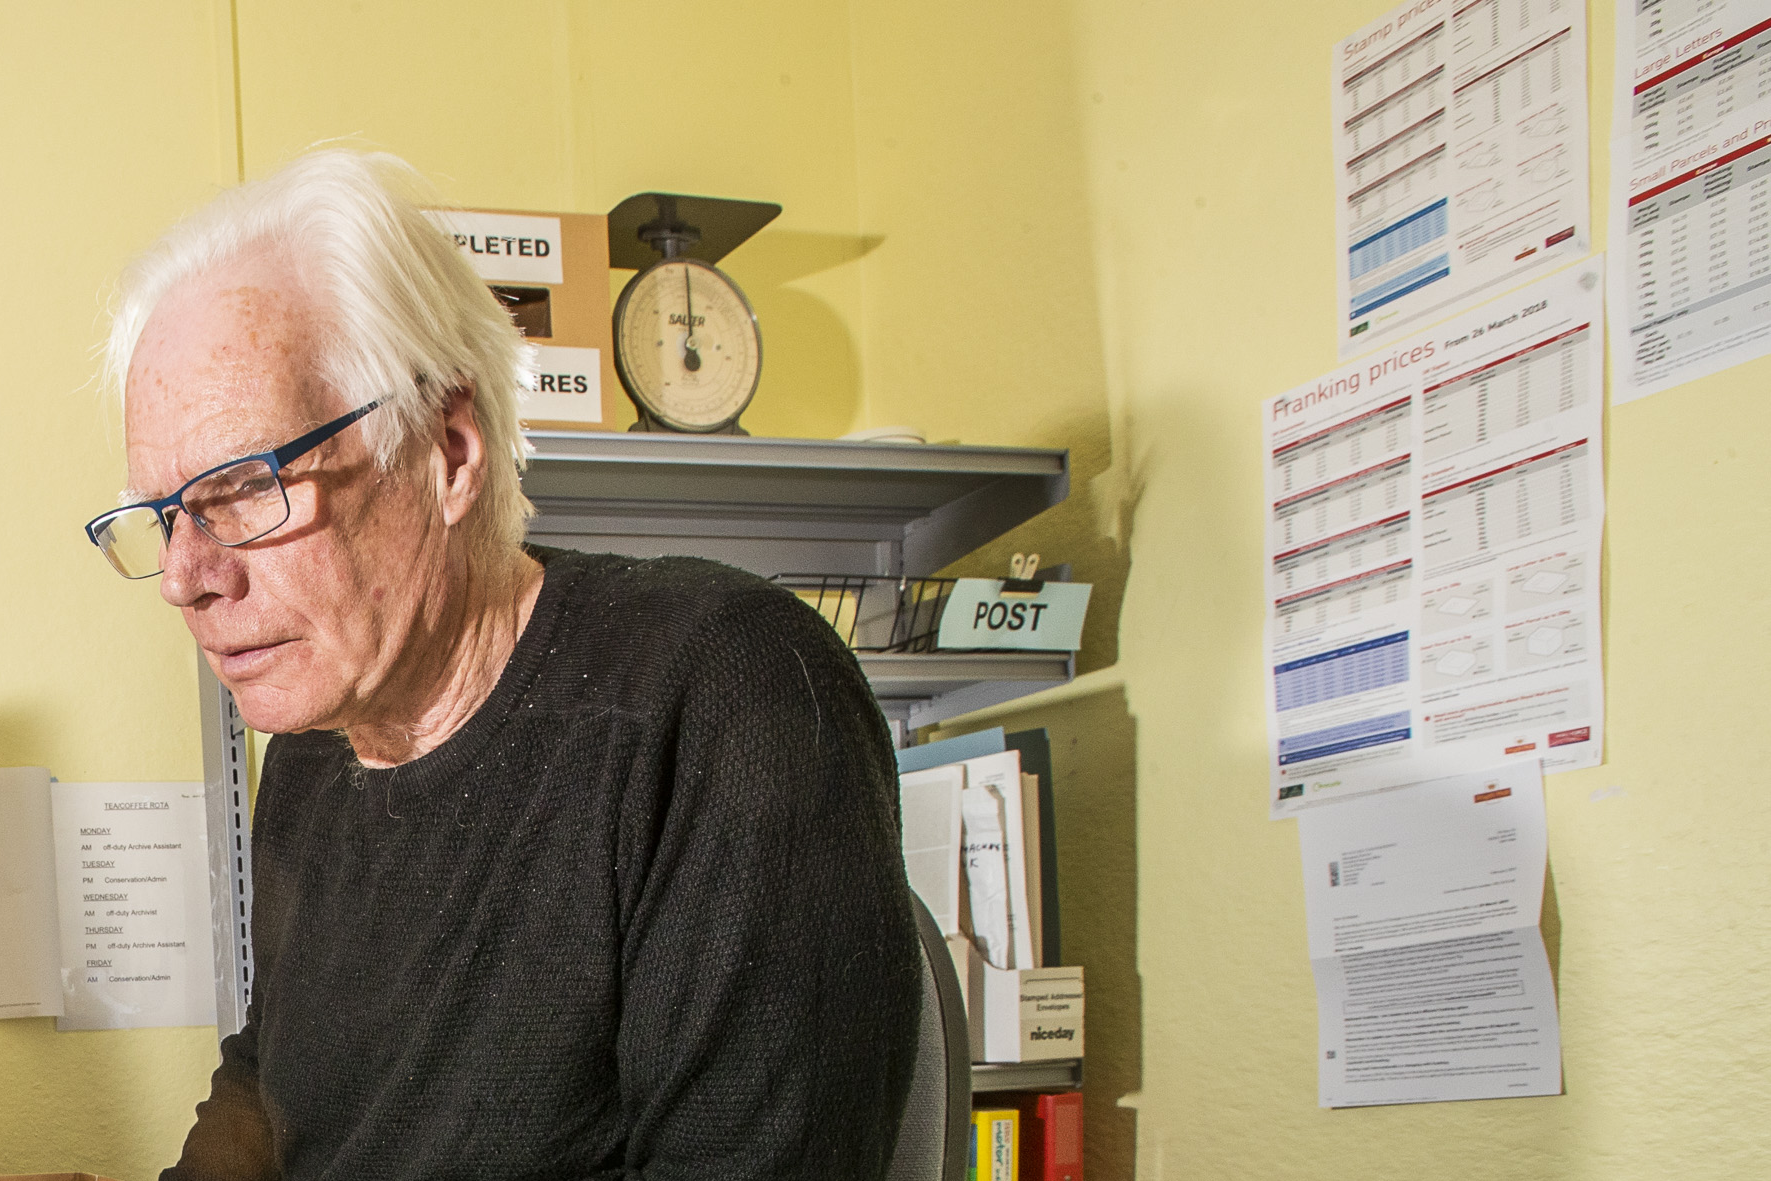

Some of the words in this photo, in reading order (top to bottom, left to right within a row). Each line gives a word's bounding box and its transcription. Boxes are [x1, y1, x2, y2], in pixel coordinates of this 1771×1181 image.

[1344, 22, 1393, 61] Stamp
[1397, 0, 1442, 29] pric
[1635, 54, 1671, 79] Large
[1675, 27, 1723, 58] Letters
[1630, 165, 1667, 191] Small
[1670, 143, 1718, 172] Parcels
[1722, 127, 1749, 149] and
[1272, 373, 1360, 422] Franking
[1369, 341, 1436, 385] prices
[1444, 334, 1470, 350] From
[1472, 326, 1485, 340] 26
[1488, 313, 1519, 332] March
[1522, 300, 1549, 318] 2018
[531, 374, 589, 394] RES
[973, 602, 1048, 631] POST
[104, 802, 148, 810] TEA/COFFEE
[81, 860, 115, 868] TUESDAY
[104, 876, 167, 884] Conservation/Admin
[83, 893, 128, 901] WEDNESDAY
[85, 926, 123, 934] THURSDAY
[109, 975, 171, 983] Conservation/Admin
[1030, 1026, 1075, 1041] niceday
